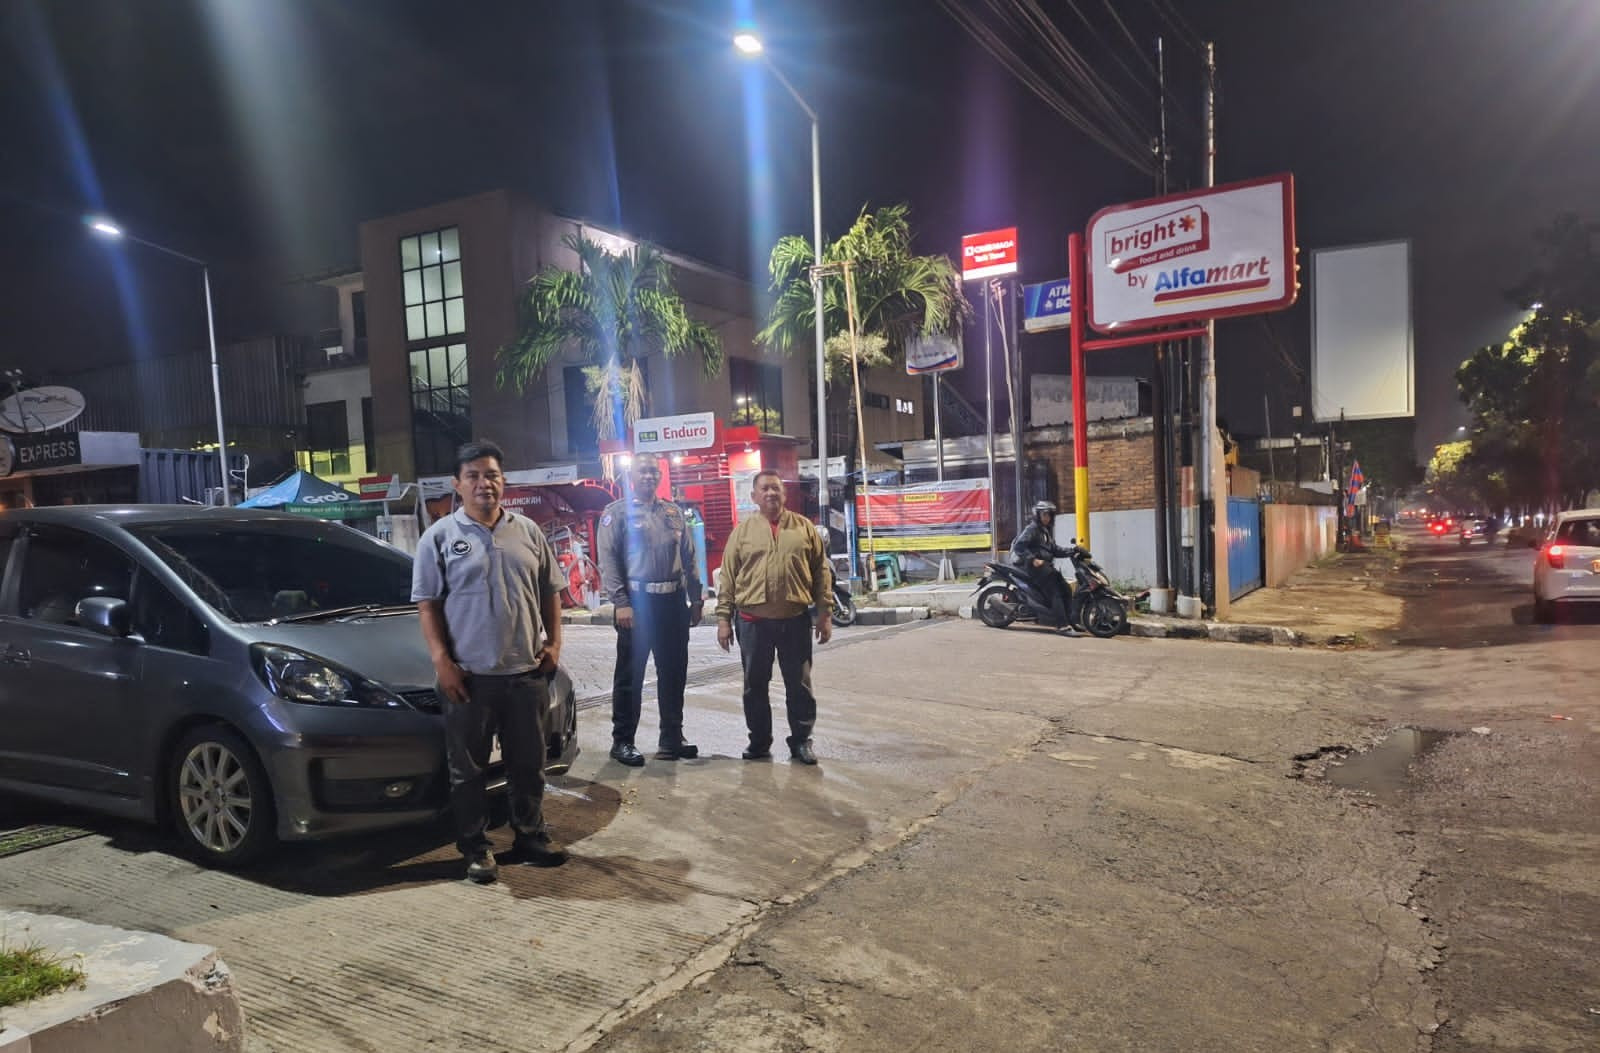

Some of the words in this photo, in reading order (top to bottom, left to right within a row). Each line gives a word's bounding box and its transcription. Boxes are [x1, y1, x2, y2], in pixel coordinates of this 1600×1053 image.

[1110, 219, 1177, 255] bright
[1139, 251, 1158, 265] food
[1159, 248, 1175, 260] and
[1127, 272, 1149, 289] by
[1154, 256, 1271, 292] Alfamart
[1048, 284, 1071, 299] ATM
[1055, 296, 1072, 309] BC
[663, 425, 708, 441] Enduro
[20, 440, 77, 463] EXPRESS
[302, 490, 350, 504] Grab
